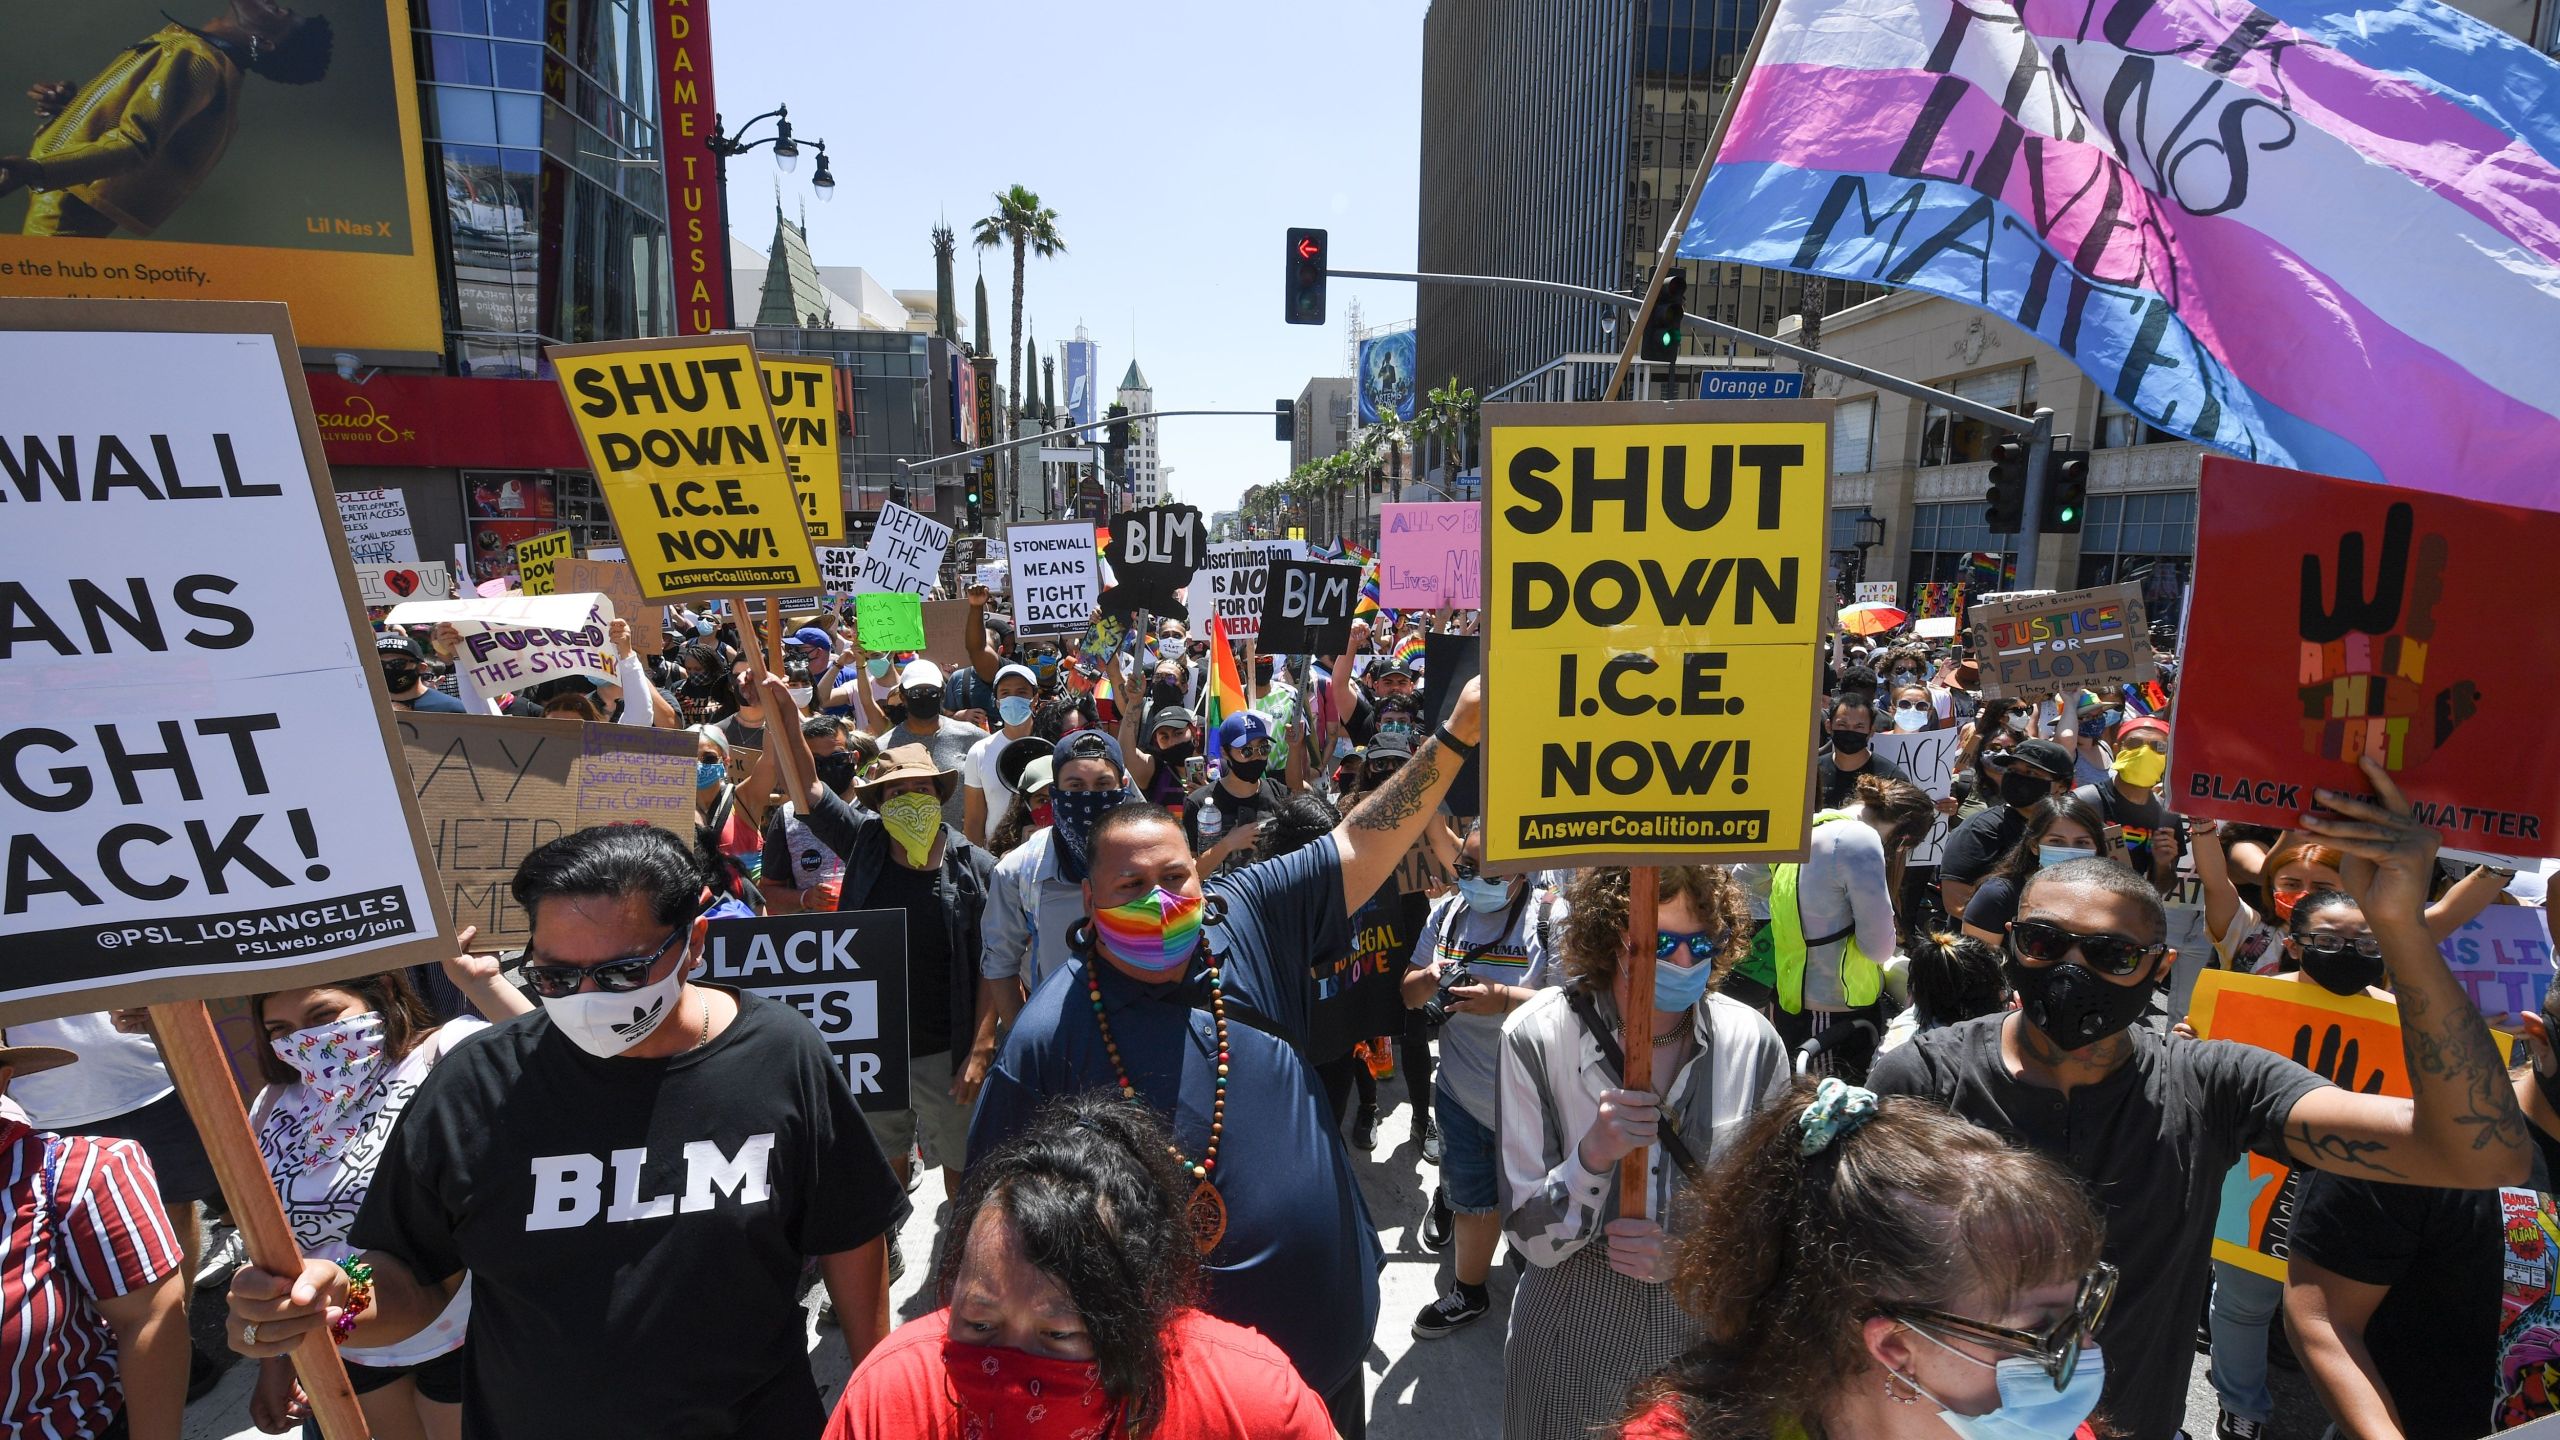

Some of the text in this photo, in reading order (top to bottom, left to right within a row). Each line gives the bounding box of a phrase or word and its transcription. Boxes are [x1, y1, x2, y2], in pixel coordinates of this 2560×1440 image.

[306, 217, 392, 238] Lil Nas X
[683, 156, 711, 333] TUSSAU
[17, 259, 53, 277] the
[57, 260, 98, 279] hub
[103, 265, 130, 281] on
[134, 263, 212, 288] Spotify.
[573, 358, 742, 419] SHUT
[1709, 376, 1794, 399] Orange Dr
[597, 424, 770, 473] DOWN
[0, 432, 283, 502] WALL
[649, 479, 760, 519] I.C.E.
[1503, 444, 1805, 535] SHUT
[369, 507, 405, 519] ACCESS
[880, 503, 949, 552] DEFUND
[1390, 511, 1434, 534] ALL
[519, 535, 567, 563] SHUT
[657, 527, 780, 563] NOW!
[888, 536, 927, 570] THE
[1013, 538, 1092, 553] STONEWALL
[1124, 510, 1195, 568] BLM
[825, 550, 856, 564] SAY
[1023, 560, 1086, 577] MEANS
[418, 568, 446, 597] U
[663, 568, 796, 590] AnswerCoalition.org
[862, 556, 931, 597] POLICE
[1211, 575, 1226, 594] IS
[1389, 565, 1439, 593] Lives
[1026, 584, 1086, 603] FIGHT
[1218, 598, 1246, 617] FOR
[1281, 568, 1350, 627] BLM
[1511, 556, 1800, 630] DOWN
[2003, 604, 2013, 614] I
[2016, 600, 2045, 612] Can't
[1027, 602, 1089, 621] BACK!
[1991, 605, 2122, 648] JUSTICE
[464, 624, 605, 664] FUCKED
[2032, 638, 2081, 655] FOR
[469, 658, 523, 688] THE
[1999, 649, 2130, 684] FLOYD
[1557, 652, 1745, 718] I.C.E.
[2016, 684, 2046, 696] They
[1241, 716, 1257, 729] LA
[582, 763, 637, 785] Sandra
[1540, 739, 1751, 799] NOW!
[1888, 733, 1957, 783] ACK
[578, 784, 688, 811] Eric Garner
[2189, 772, 2302, 811] BLACK
[1523, 814, 1761, 843] AnswerCoalition.org
[2411, 800, 2543, 842] MATTER
[2, 807, 332, 916] ACK!
[96, 894, 401, 950] @PSL_LOSANGELES
[235, 917, 406, 957] PSLweb.org/join
[625, 1022, 658, 1043] adidas
[525, 1132, 776, 1232] BLM
